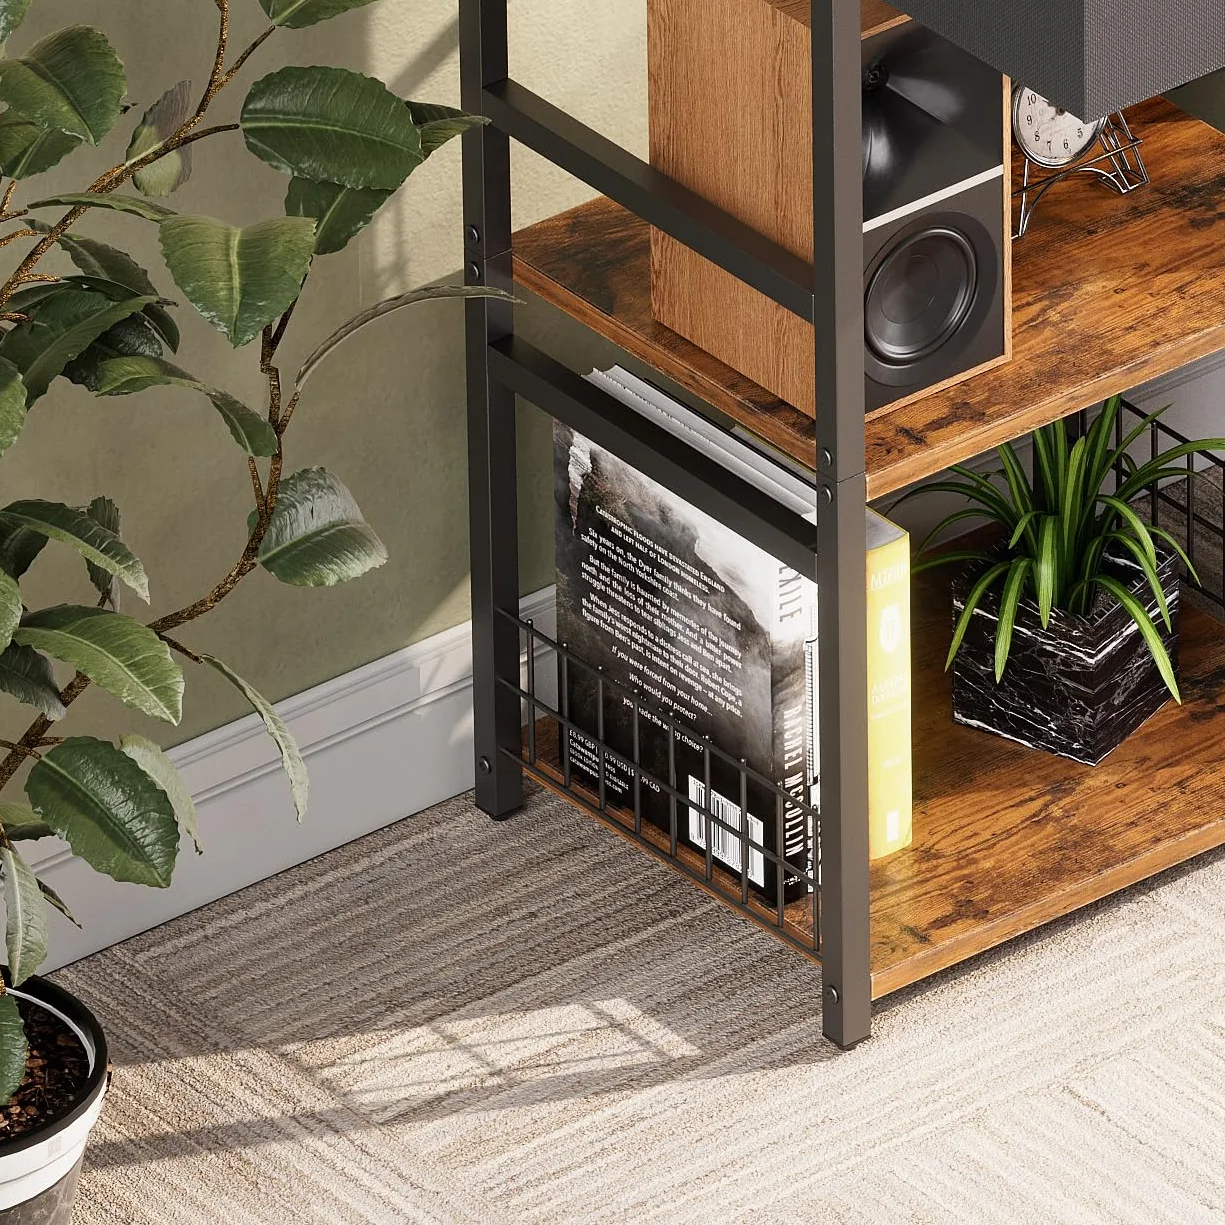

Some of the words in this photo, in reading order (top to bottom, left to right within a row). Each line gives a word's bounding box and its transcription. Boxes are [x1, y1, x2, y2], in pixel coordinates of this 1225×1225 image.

[1026, 115, 1033, 125] 9
[1027, 93, 1037, 106] 10
[1034, 130, 1041, 142] 8
[1046, 140, 1052, 152] 7
[1063, 138, 1069, 150] 6
[1077, 127, 1084, 139] 5
[581, 534, 598, 550] safety
[607, 550, 617, 561] the
[618, 556, 634, 572] North
[635, 567, 661, 590] Yorkshire
[611, 526, 622, 537] AND
[635, 542, 647, 553] HALF
[658, 554, 679, 574] LONDON
[634, 530, 653, 547] FLOODS
[654, 544, 667, 556] HAVE
[669, 553, 699, 576] DEVASTATED
[700, 571, 724, 592] ENGLAND
[589, 527, 597, 538] Six
[599, 535, 614, 550] years
[616, 546, 625, 557] on,
[627, 552, 636, 563] the
[639, 559, 651, 573] Dyer
[654, 568, 672, 587] family
[673, 582, 691, 598] thinks
[693, 594, 706, 609] they
[708, 603, 722, 618] have
[723, 613, 740, 630] found
[581, 562, 597, 576] north
[599, 573, 610, 584] and
[612, 580, 622, 591] the
[624, 587, 635, 600] loss
[645, 602, 659, 615] their
[685, 628, 697, 640] And
[706, 639, 722, 655] bitter
[723, 652, 741, 668] power
[582, 572, 605, 591] struggle
[606, 587, 633, 609] threatens
[641, 609, 652, 621] tear
[653, 618, 676, 637] siblings
[677, 632, 689, 645] Jess
[690, 642, 701, 653] and
[702, 648, 714, 661] Ben
[590, 554, 599, 567] But
[600, 562, 610, 573] the
[611, 568, 629, 587] family
[636, 584, 660, 606] haunted
[671, 608, 699, 631] memories
[708, 631, 718, 642] the
[718, 638, 741, 659] journey
[582, 598, 592, 609] the
[615, 620, 631, 635] worst
[632, 631, 662, 654] nightmare
[670, 654, 683, 668] their
[700, 674, 720, 692] Robert
[582, 608, 599, 625] figure
[600, 619, 614, 634] from
[652, 653, 669, 670] intent
[678, 672, 702, 691] revenge
[714, 695, 725, 707] any
[590, 592, 607, 609] When
[608, 605, 620, 617] Jess
[621, 614, 647, 635] responds
[660, 638, 681, 657] distress
[682, 653, 692, 664] call
[712, 672, 722, 683] she
[723, 678, 742, 696] brings
[617, 650, 628, 661] you
[629, 658, 643, 670] were
[644, 666, 663, 683] forced
[662, 677, 676, 691] from
[676, 689, 690, 700] your
[629, 672, 642, 685] Who
[643, 683, 661, 698] would
[661, 695, 672, 705] you
[673, 702, 696, 720] protect?
[623, 697, 633, 708] you
[639, 707, 651, 719] ade
[652, 715, 661, 726] the
[682, 736, 703, 752] choice?
[783, 704, 803, 770] RACHEL
[616, 759, 627, 772] USD
[649, 780, 659, 793] CAD
